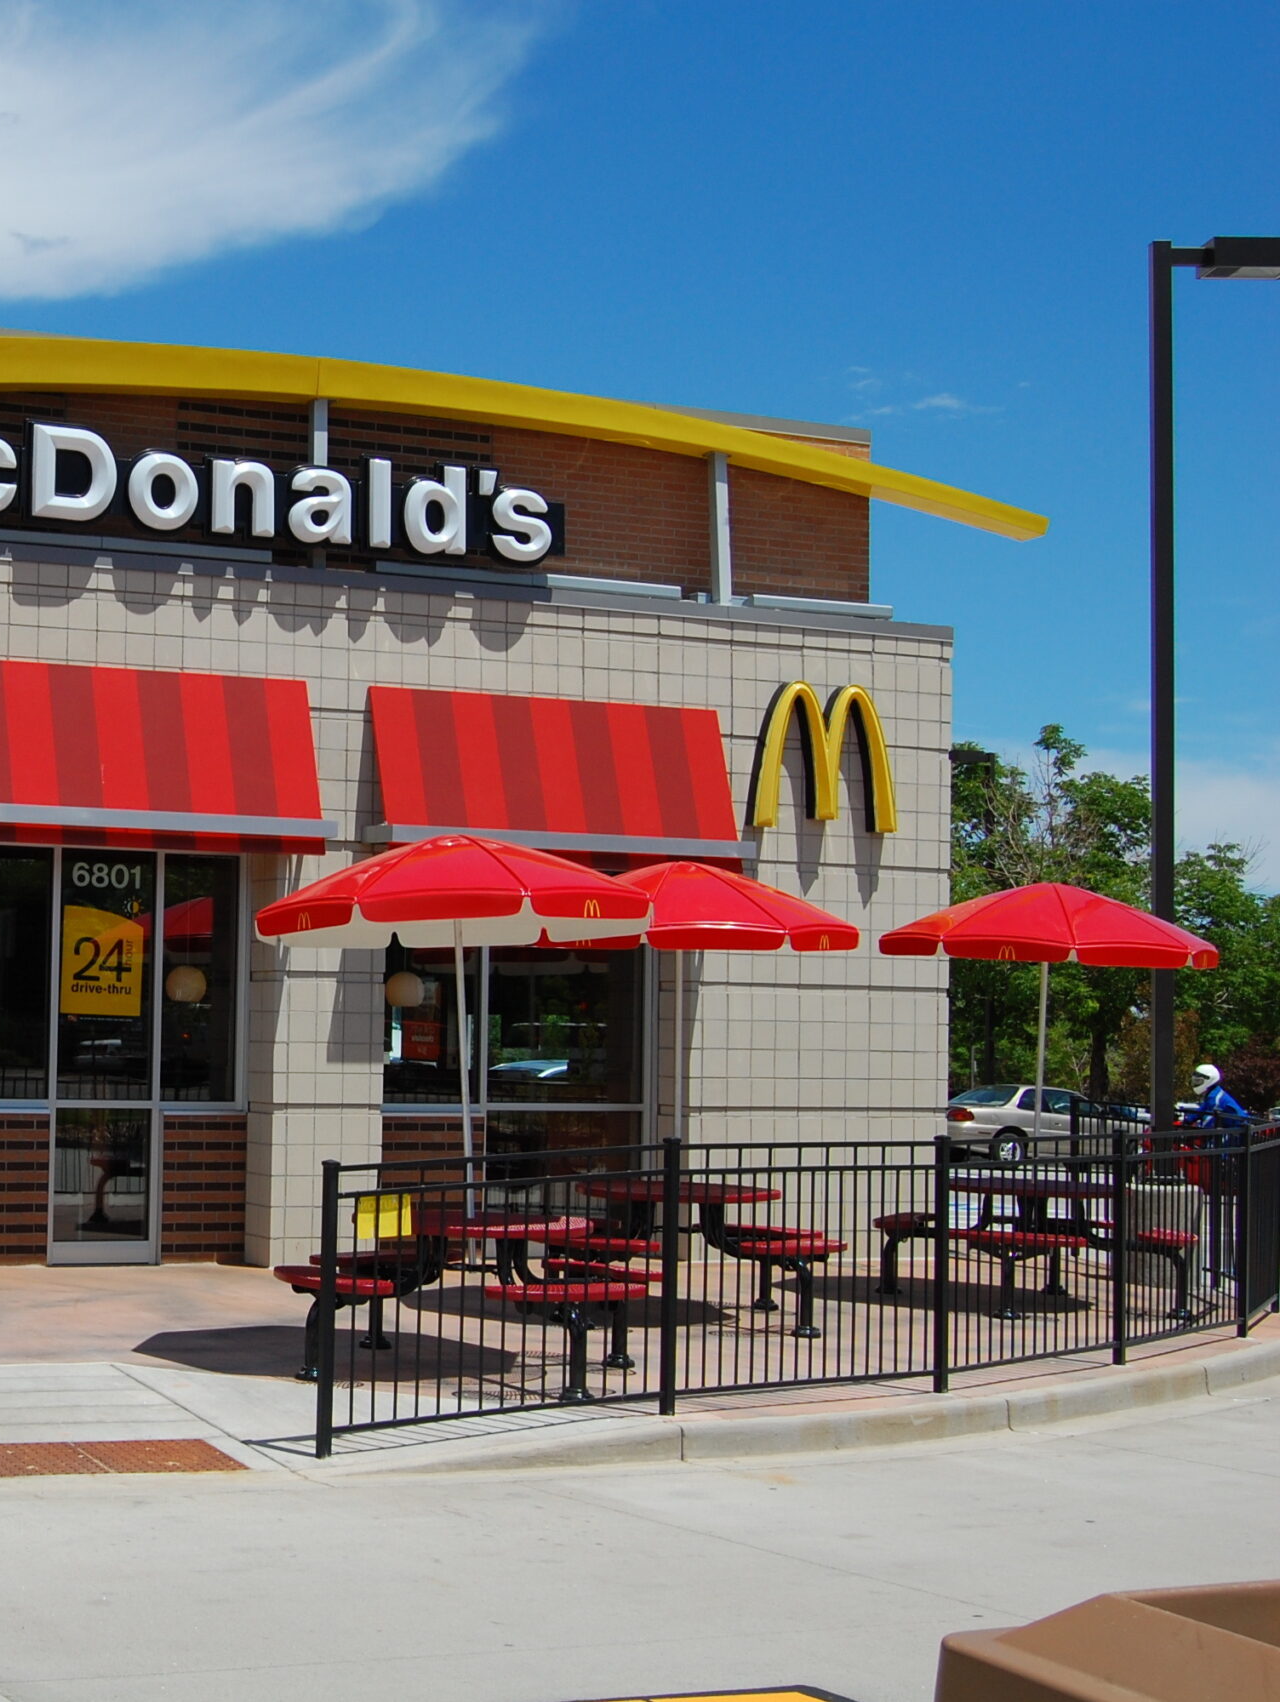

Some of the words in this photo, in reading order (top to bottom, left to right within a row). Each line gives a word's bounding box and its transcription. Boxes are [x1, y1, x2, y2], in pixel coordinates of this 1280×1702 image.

[72, 862, 141, 889] 6801
[73, 936, 132, 982] 24
[124, 939, 134, 967] hour
[71, 982, 132, 995] drive-thru
